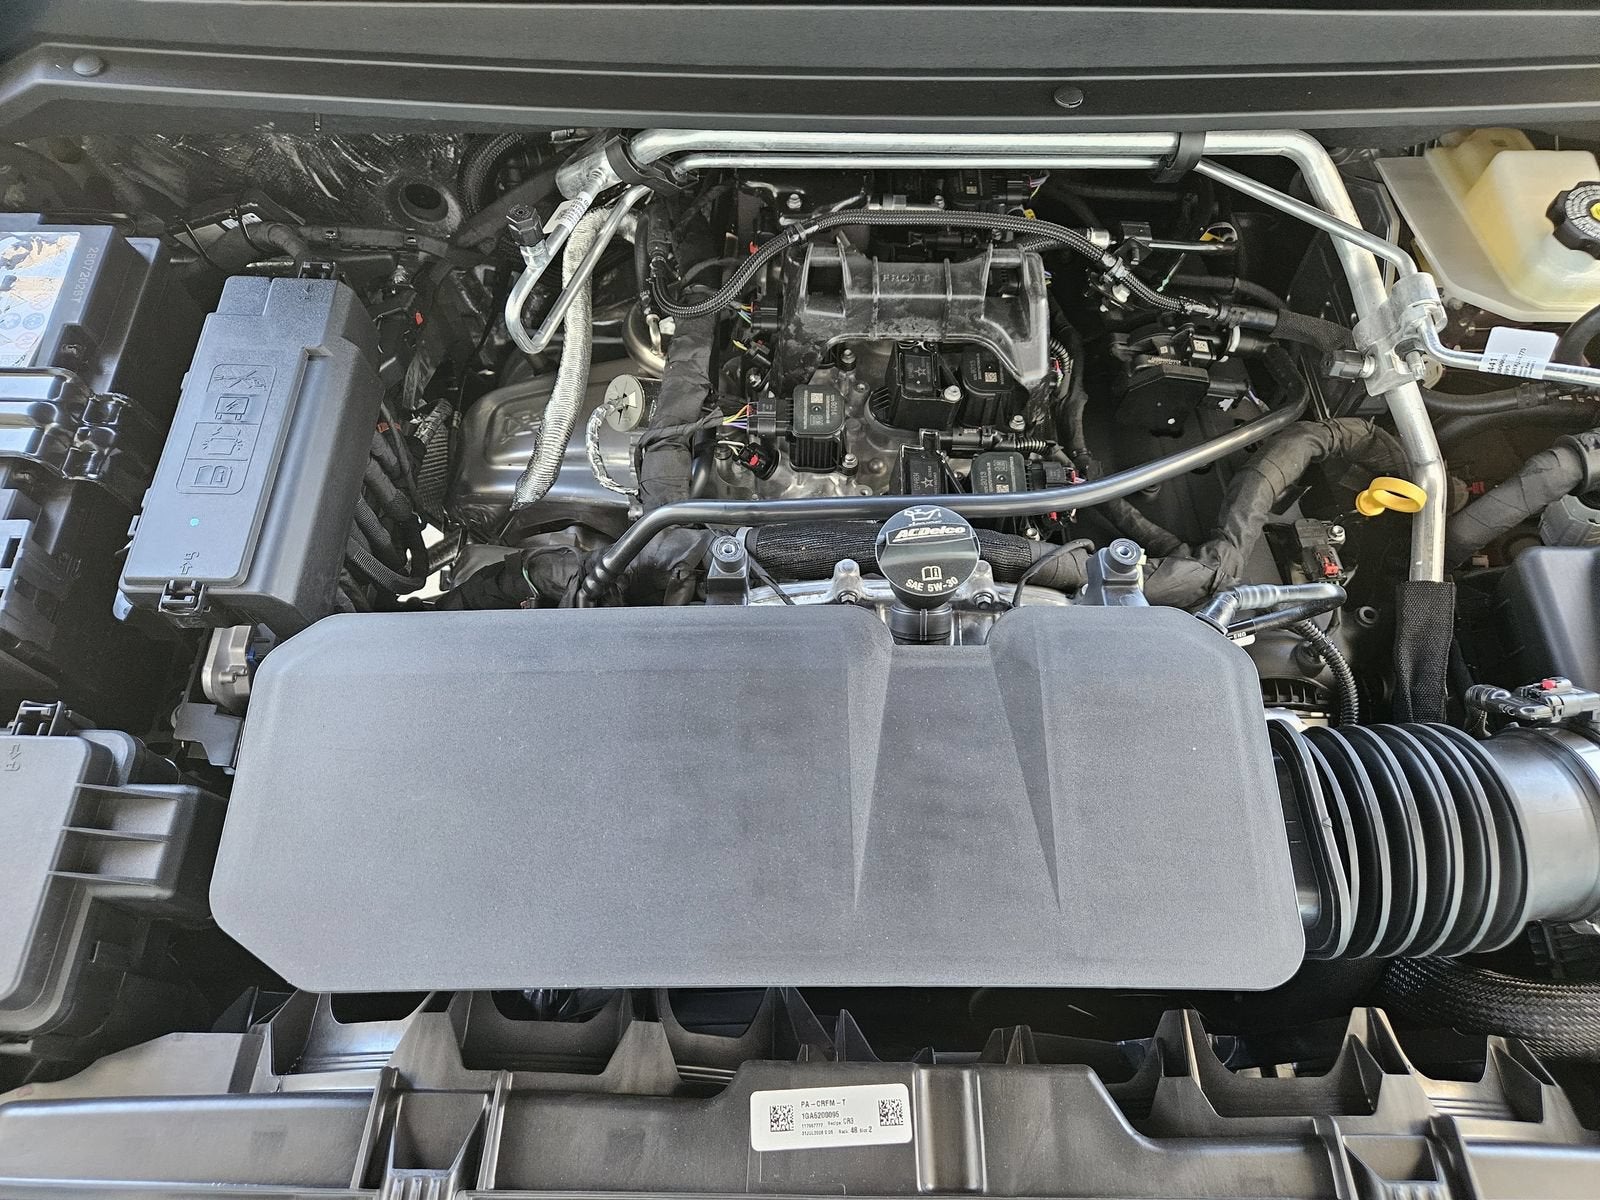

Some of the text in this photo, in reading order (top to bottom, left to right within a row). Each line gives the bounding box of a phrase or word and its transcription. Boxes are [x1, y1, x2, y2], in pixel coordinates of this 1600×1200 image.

[894, 525, 966, 540] ACDelco
[905, 576, 959, 592] SAE 5W-30
